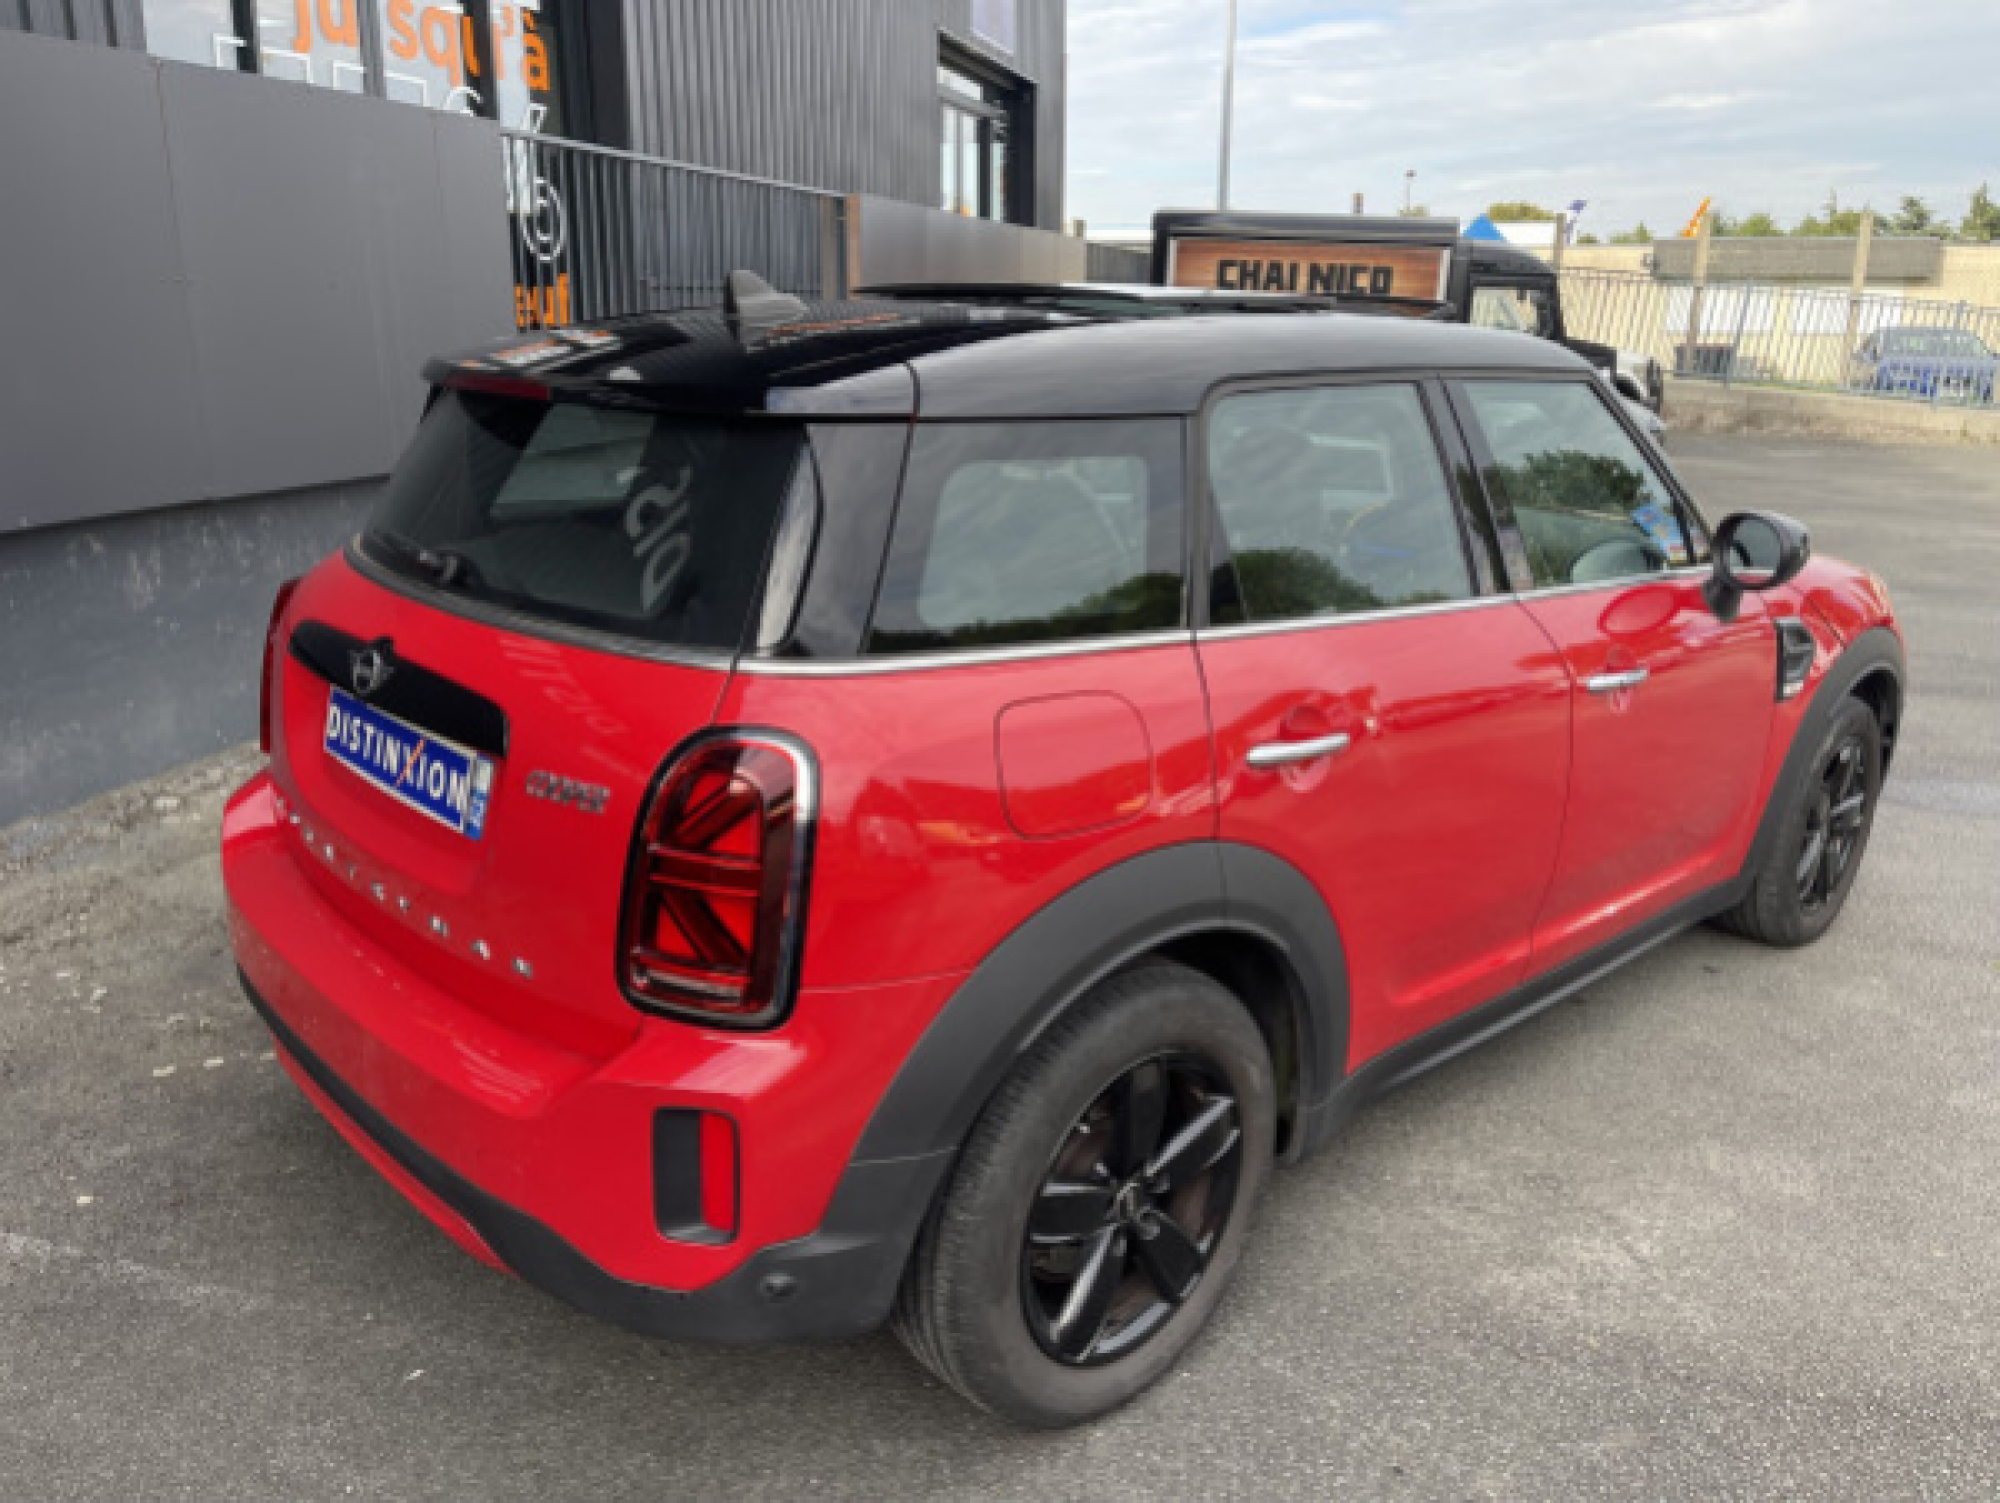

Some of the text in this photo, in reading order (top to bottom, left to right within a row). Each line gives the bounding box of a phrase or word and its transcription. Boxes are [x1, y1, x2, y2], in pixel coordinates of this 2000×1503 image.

[1218, 260, 1394, 294] CHAI NICO
[326, 702, 469, 816] DISTINXION
